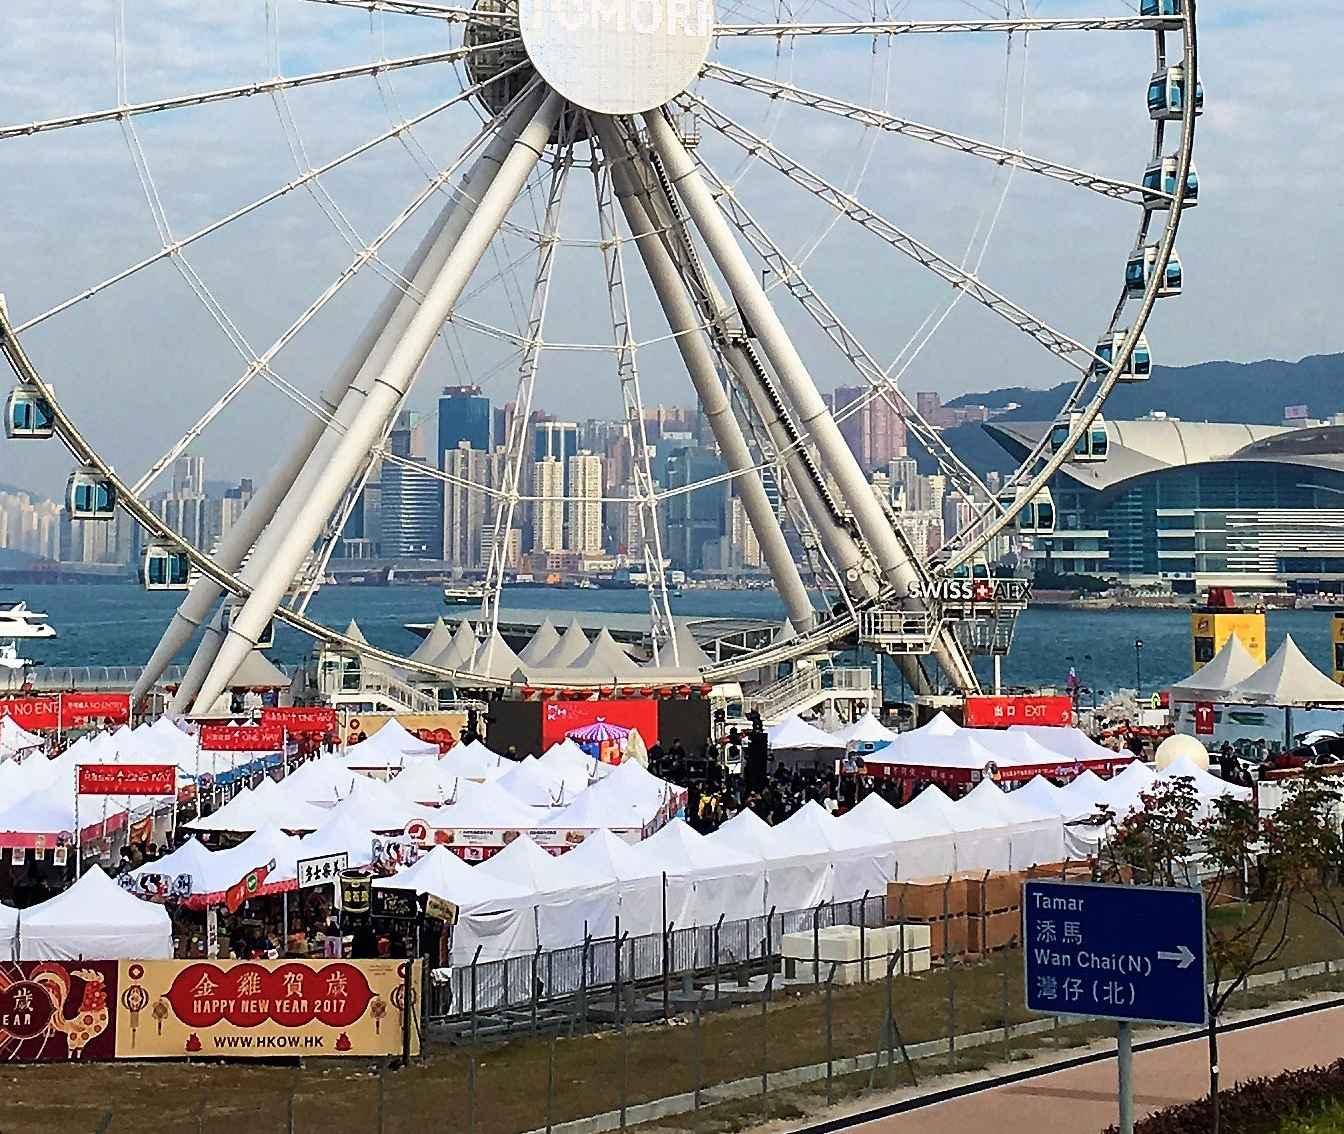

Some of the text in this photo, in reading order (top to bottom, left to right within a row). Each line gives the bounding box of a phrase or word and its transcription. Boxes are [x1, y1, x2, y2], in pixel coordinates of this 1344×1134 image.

[908, 580, 1033, 599] SWISS AEX
[14, 702, 32, 716] NO
[35, 701, 60, 715] ENT
[90, 701, 100, 709] NO
[101, 701, 124, 709] ENTRY
[1024, 705, 1047, 717] EXIT
[1033, 892, 1084, 911] Tamar
[1036, 919, 1083, 944] 添馬
[1034, 948, 1071, 966] Wan
[190, 970, 348, 998] 金雞賀歲
[193, 998, 346, 1014] HAPPY NEW YEAR 2017
[213, 1035, 324, 1048] WWW.HKOW.HK
